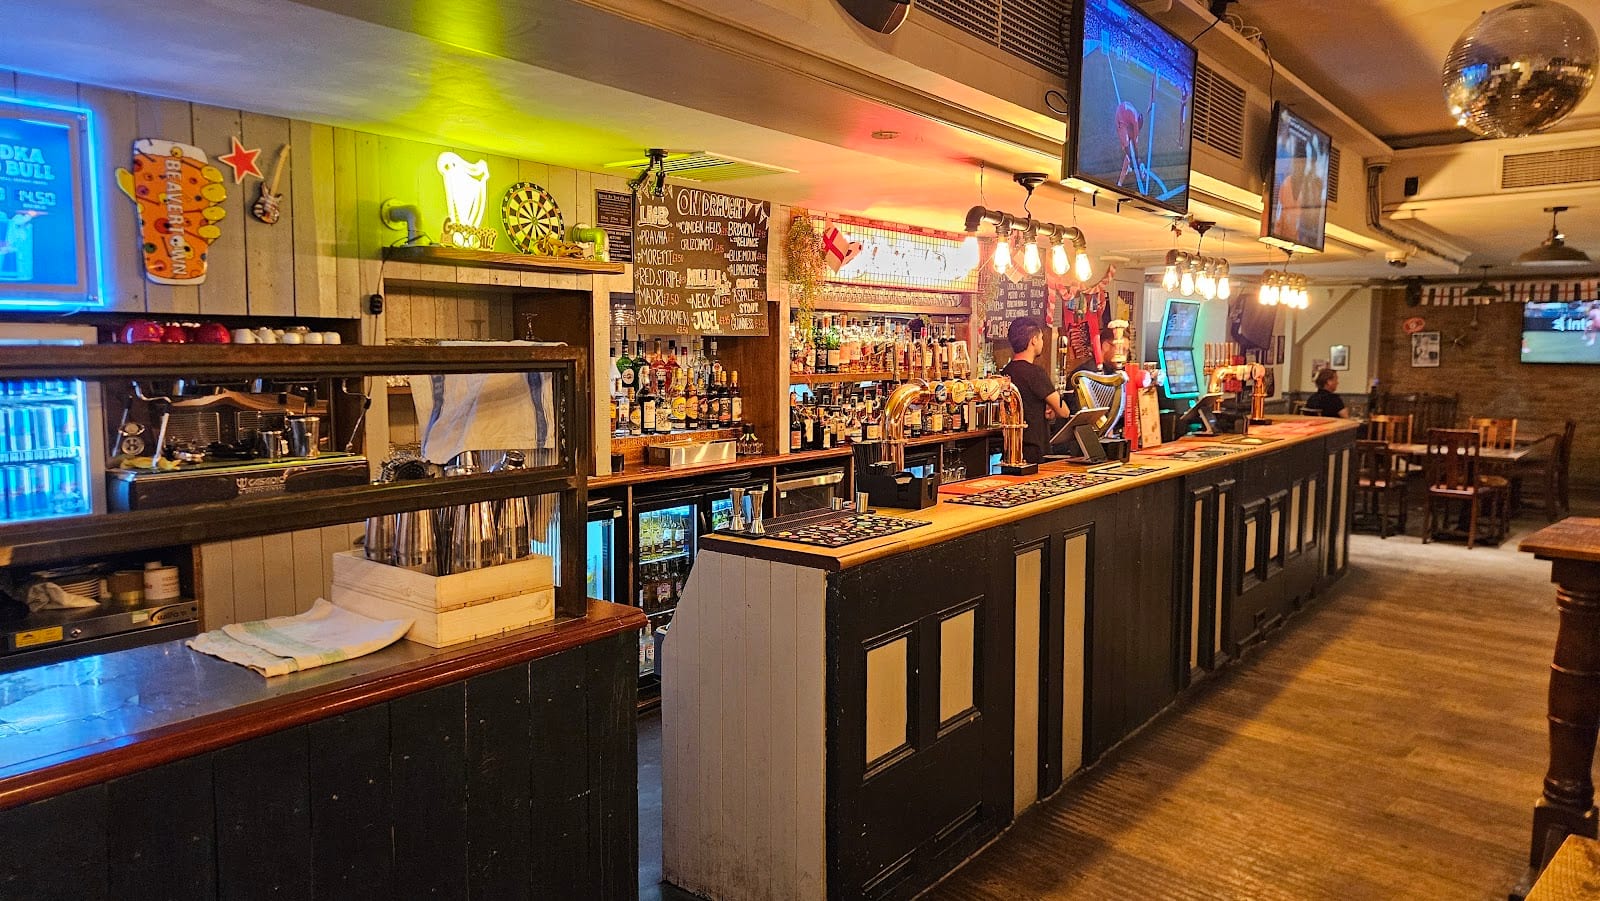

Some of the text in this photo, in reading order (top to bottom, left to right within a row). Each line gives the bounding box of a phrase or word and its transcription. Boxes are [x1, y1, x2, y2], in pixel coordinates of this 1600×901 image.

[6, 160, 55, 180] BULL
[677, 188, 745, 219] ON DRAUGHT
[165, 159, 187, 275] BEAVERTOWN
[680, 220, 704, 235] CAMDEN
[705, 220, 721, 235] HELLS
[728, 221, 755, 237] BRIXTON
[640, 229, 668, 245] PRAVHA
[680, 237, 714, 251] CRUZCAMPO
[640, 248, 673, 265] MORETTI
[729, 249, 742, 262] BLUE
[742, 250, 757, 262] MOON
[639, 267, 656, 286] RED
[656, 269, 680, 288] STRIPE
[638, 287, 665, 306] MADRI
[691, 293, 710, 309] NECK
[711, 293, 725, 308] OIL
[733, 288, 754, 303] ASPALL
[738, 302, 759, 314] STOUT
[640, 306, 690, 327] STAROPRAMEN
[692, 310, 720, 330] JUBEL
[731, 317, 755, 330] GUINNESS
